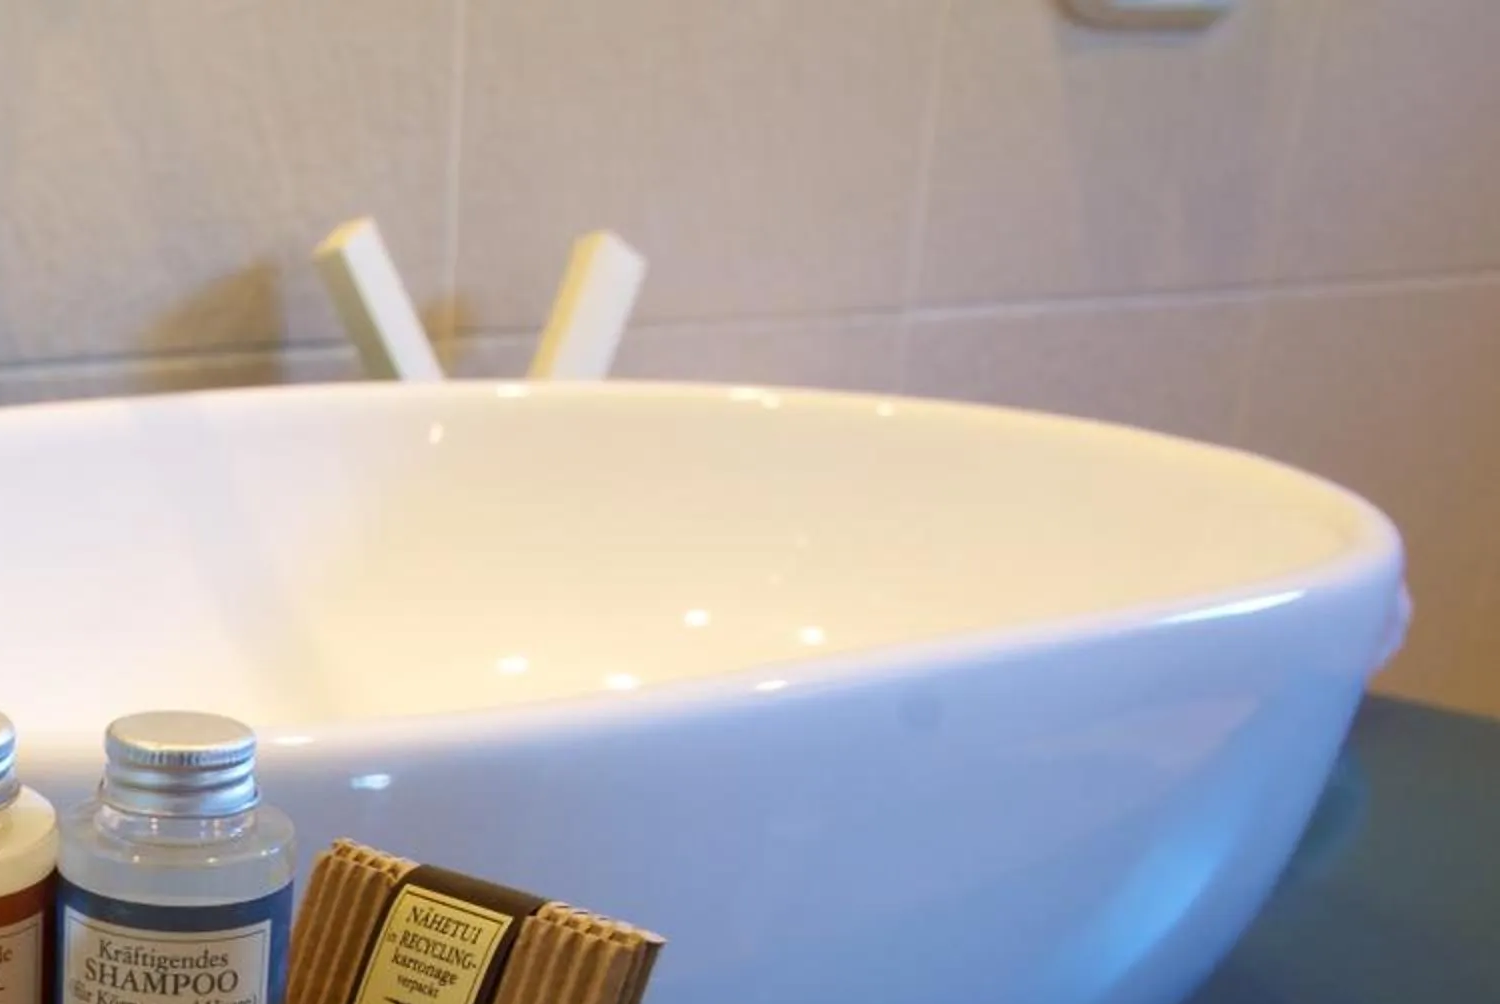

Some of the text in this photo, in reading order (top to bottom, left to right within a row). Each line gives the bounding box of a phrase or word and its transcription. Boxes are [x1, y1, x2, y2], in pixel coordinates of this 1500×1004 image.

[406, 905, 483, 944] NÄHETUI
[99, 940, 230, 973] Kräftigendes
[391, 947, 459, 987] kartonage
[399, 930, 477, 970] RECYCLING-
[85, 957, 239, 996] SHAMPOO
